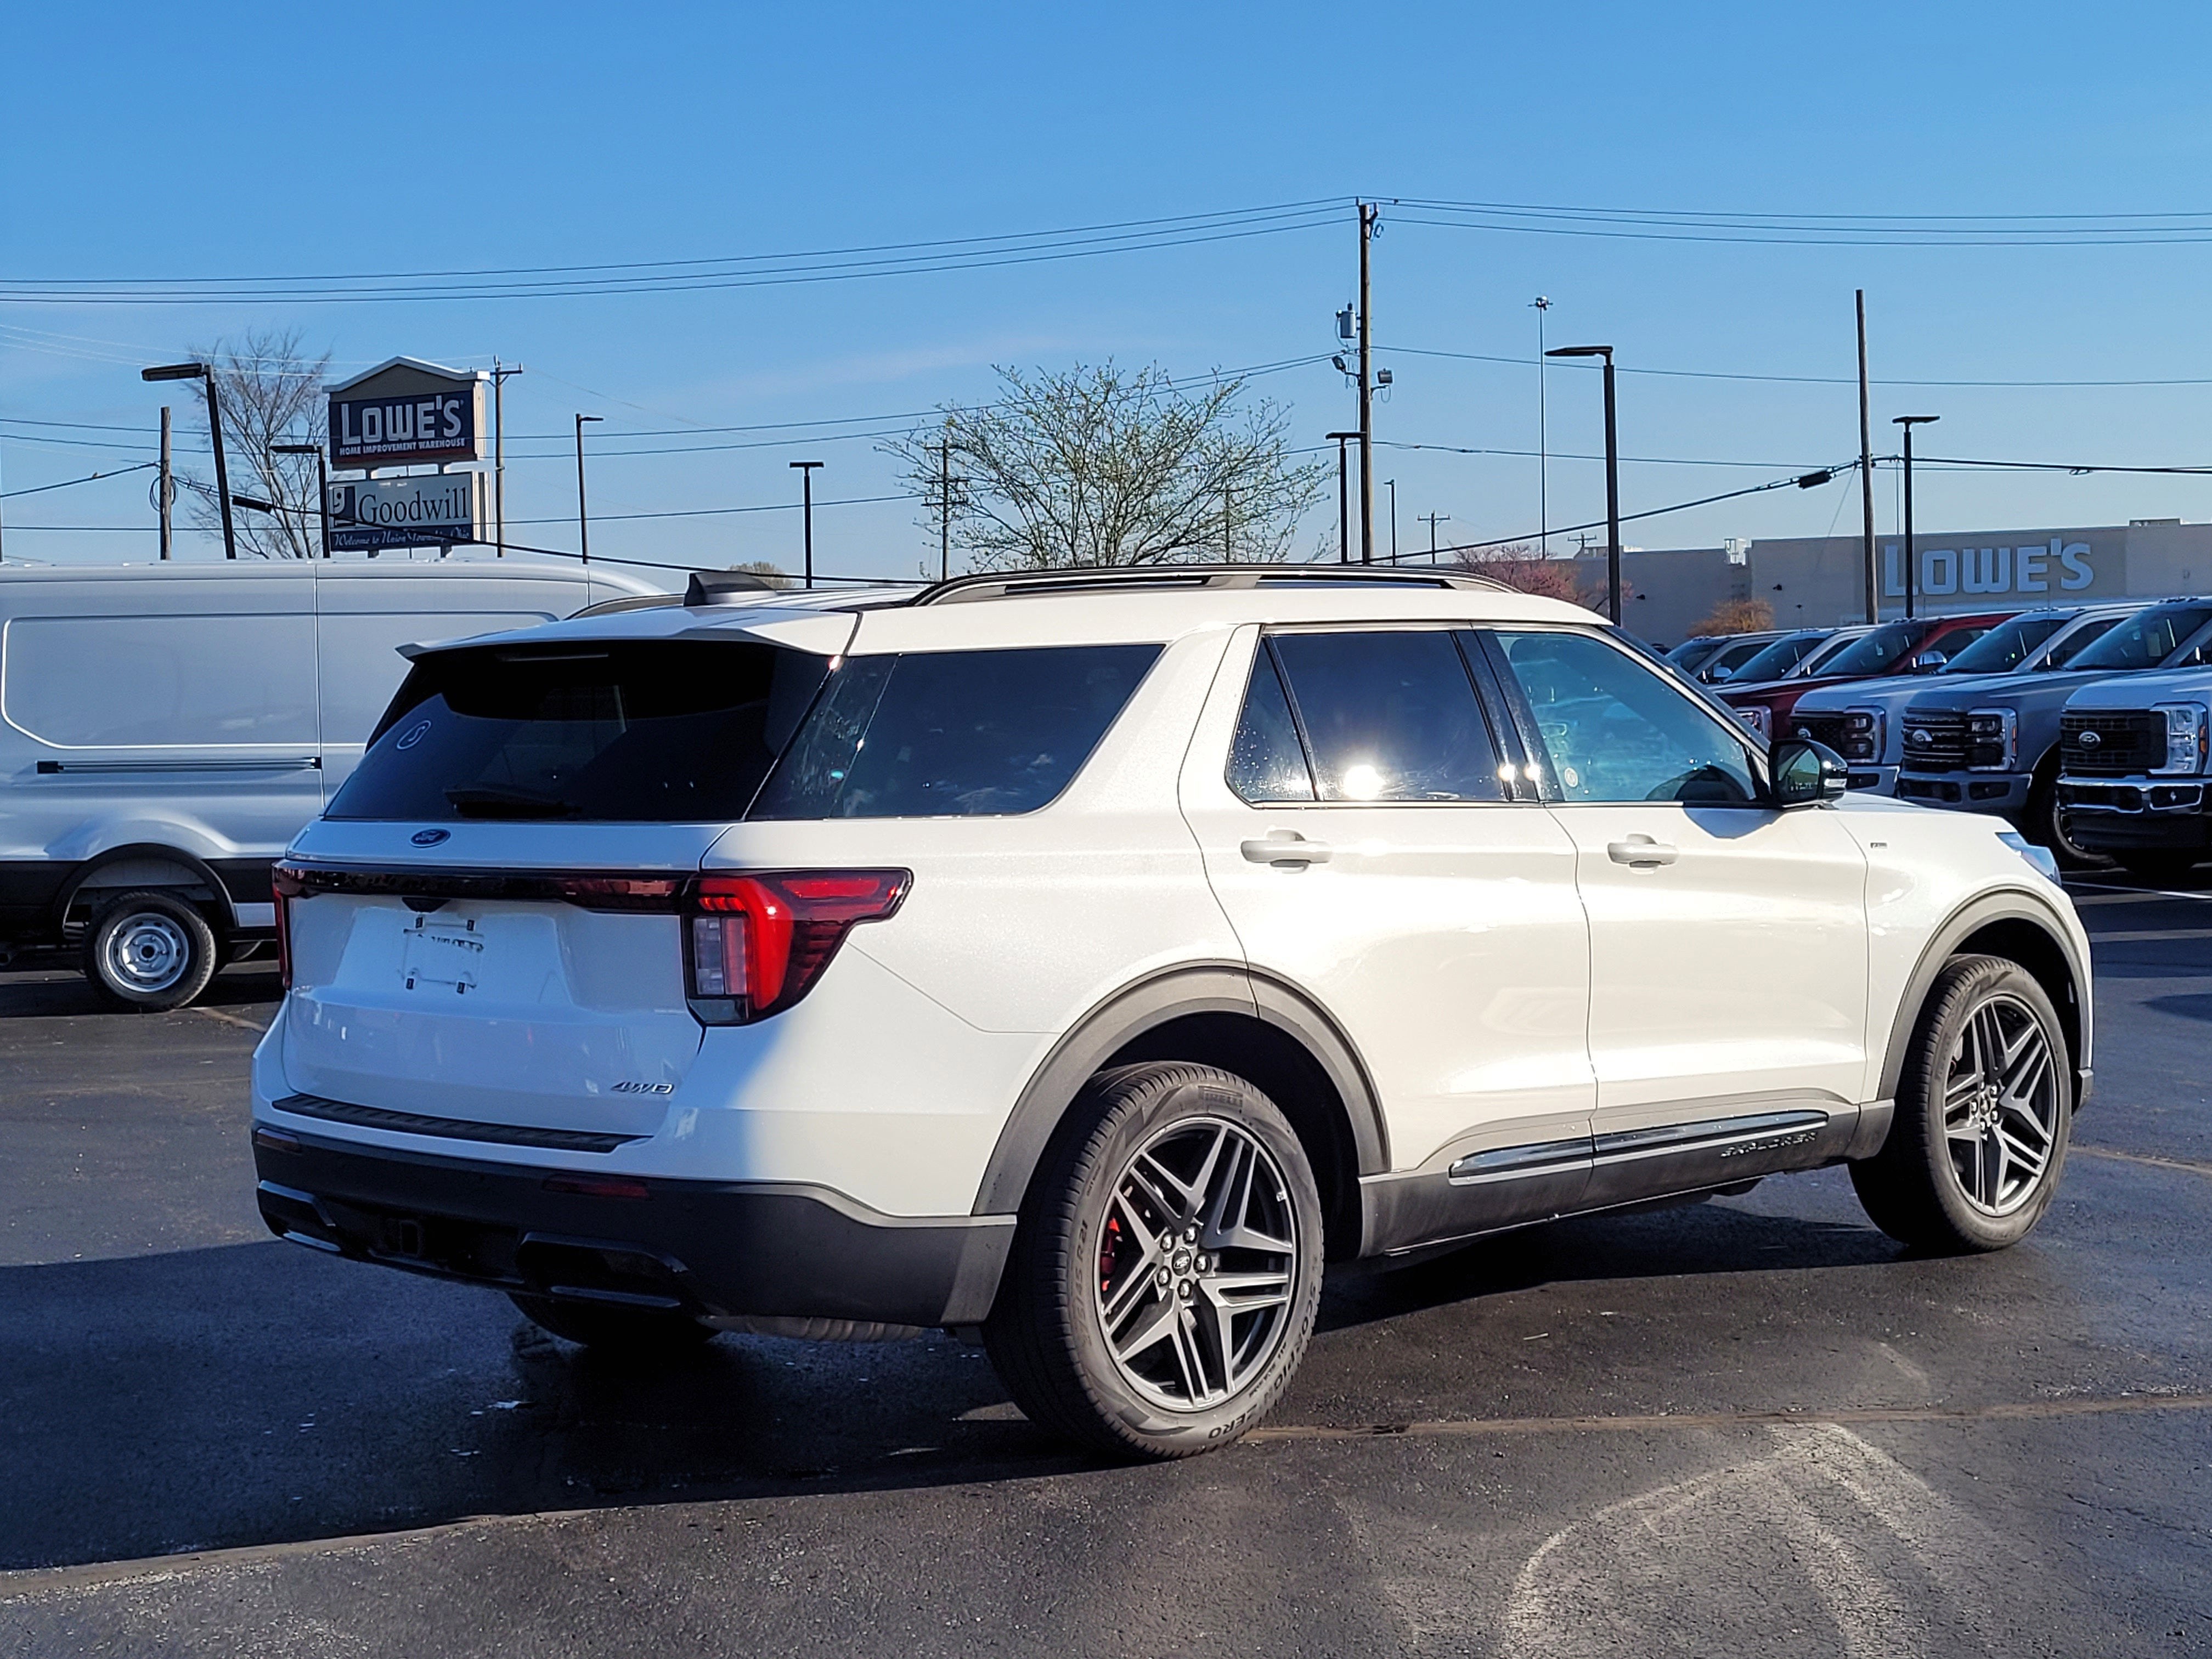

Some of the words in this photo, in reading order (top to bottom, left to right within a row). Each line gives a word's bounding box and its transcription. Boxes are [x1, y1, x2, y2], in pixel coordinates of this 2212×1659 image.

[341, 395, 462, 445] LOWE'S
[339, 446, 361, 456] HOME
[363, 442, 416, 454] IMPROVEMENT
[419, 438, 465, 450] WAREHOUSE
[358, 486, 469, 524] Goodwill
[334, 533, 370, 546] Welcome
[1883, 538, 2095, 597] LOWE'S
[610, 1081, 674, 1094] 4WD
